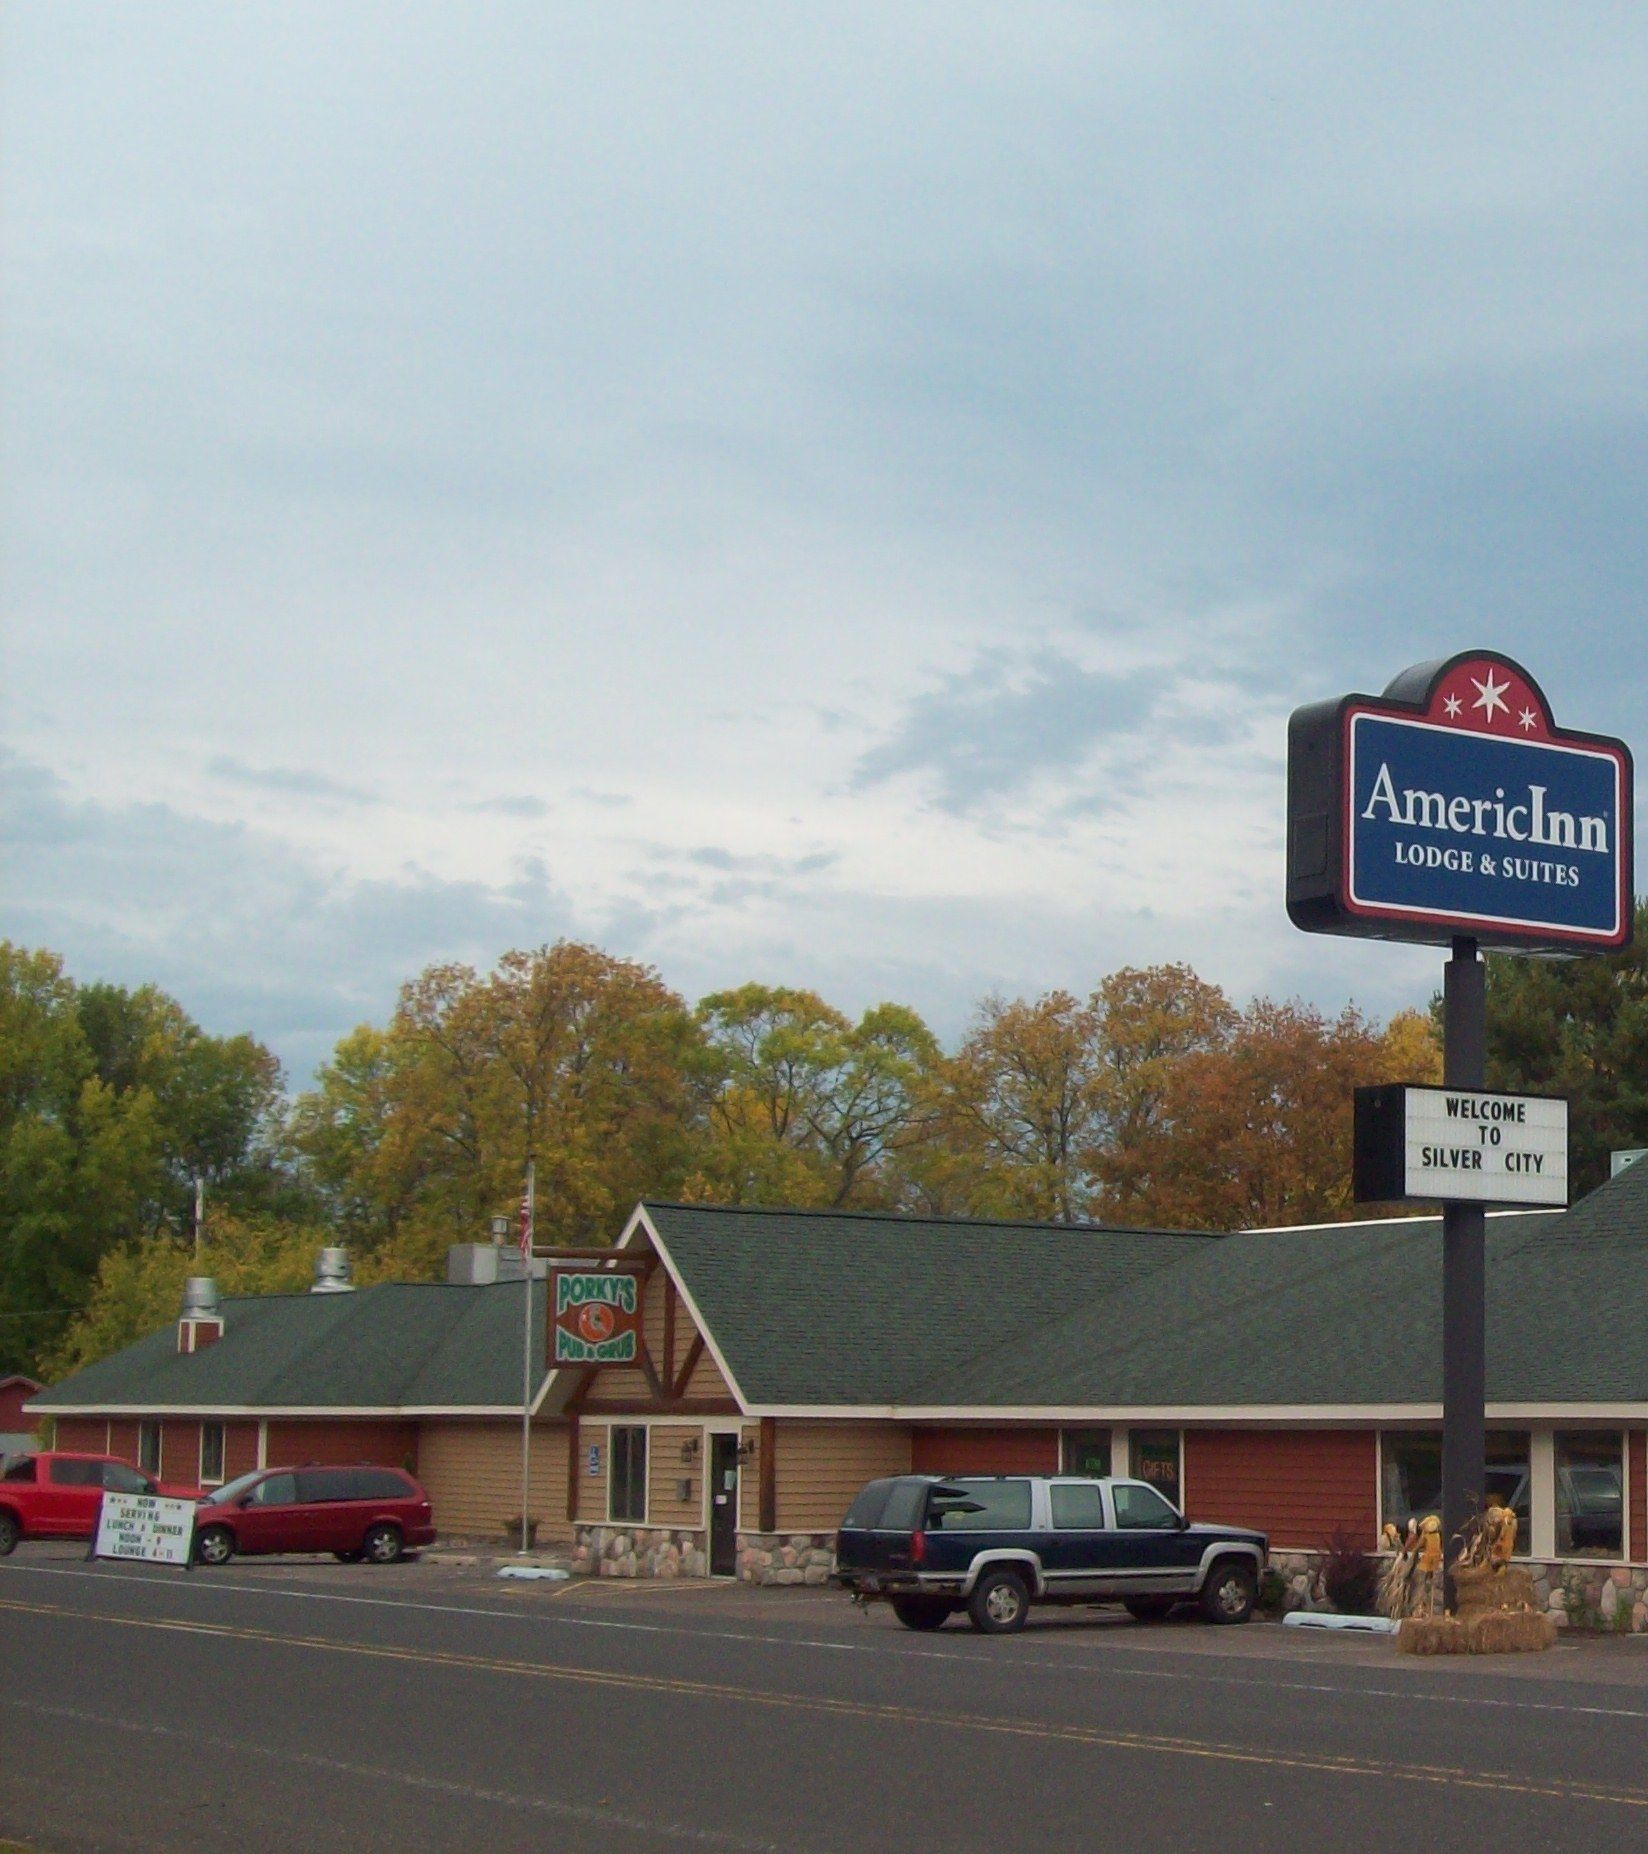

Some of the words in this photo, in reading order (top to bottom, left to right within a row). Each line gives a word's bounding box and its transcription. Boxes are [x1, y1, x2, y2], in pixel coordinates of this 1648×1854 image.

[1361, 762, 1609, 853] AmericInn
[1395, 842, 1474, 873] LODGE
[1480, 854, 1496, 876] &
[1502, 857, 1580, 887] SUITES
[1445, 1097, 1526, 1123] WELCOME
[1478, 1125, 1501, 1145] TO
[1422, 1146, 1482, 1170] SILVER
[1505, 1152, 1544, 1173] CITY
[557, 1274, 636, 1315] PORKY'S
[557, 1326, 586, 1361] PUB
[597, 1330, 636, 1361] GRUB
[1142, 1460, 1174, 1480] GIFTS
[137, 1498, 157, 1509] NOW
[121, 1508, 160, 1521] SERVING
[106, 1519, 135, 1531] LUNCH
[152, 1523, 183, 1536] DINNER
[119, 1533, 142, 1543] NOON
[112, 1544, 147, 1557] LOUNGE
